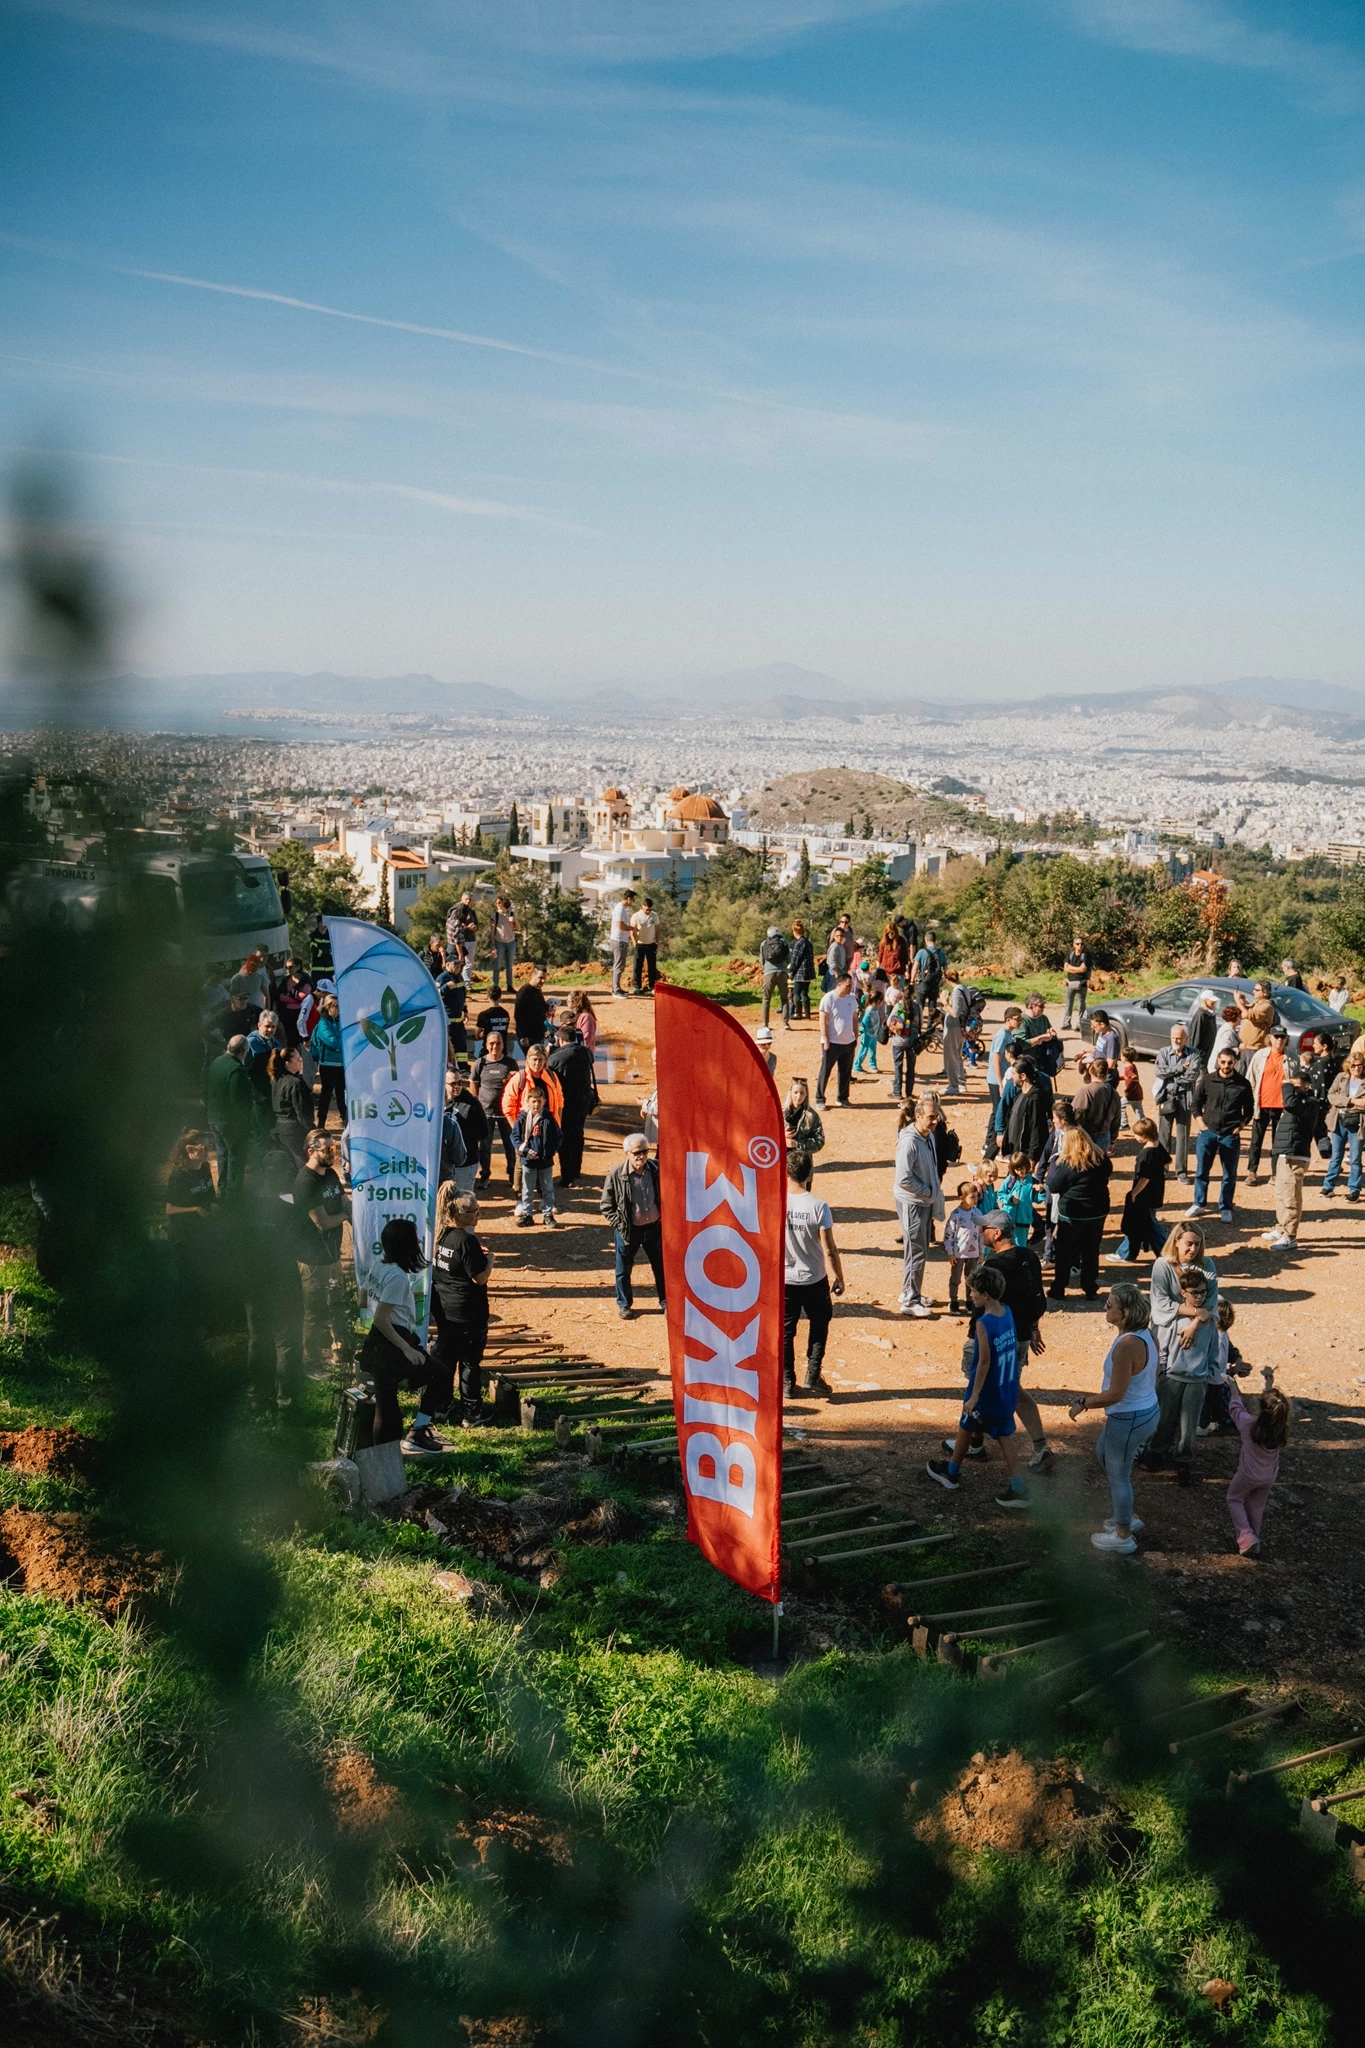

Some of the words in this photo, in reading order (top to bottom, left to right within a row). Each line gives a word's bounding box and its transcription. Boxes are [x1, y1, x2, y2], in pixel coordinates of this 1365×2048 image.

[89, 872, 96, 881] 5
[684, 1151, 761, 1519] ΒΙΚΟΣ
[998, 1348, 1016, 1386] 77
